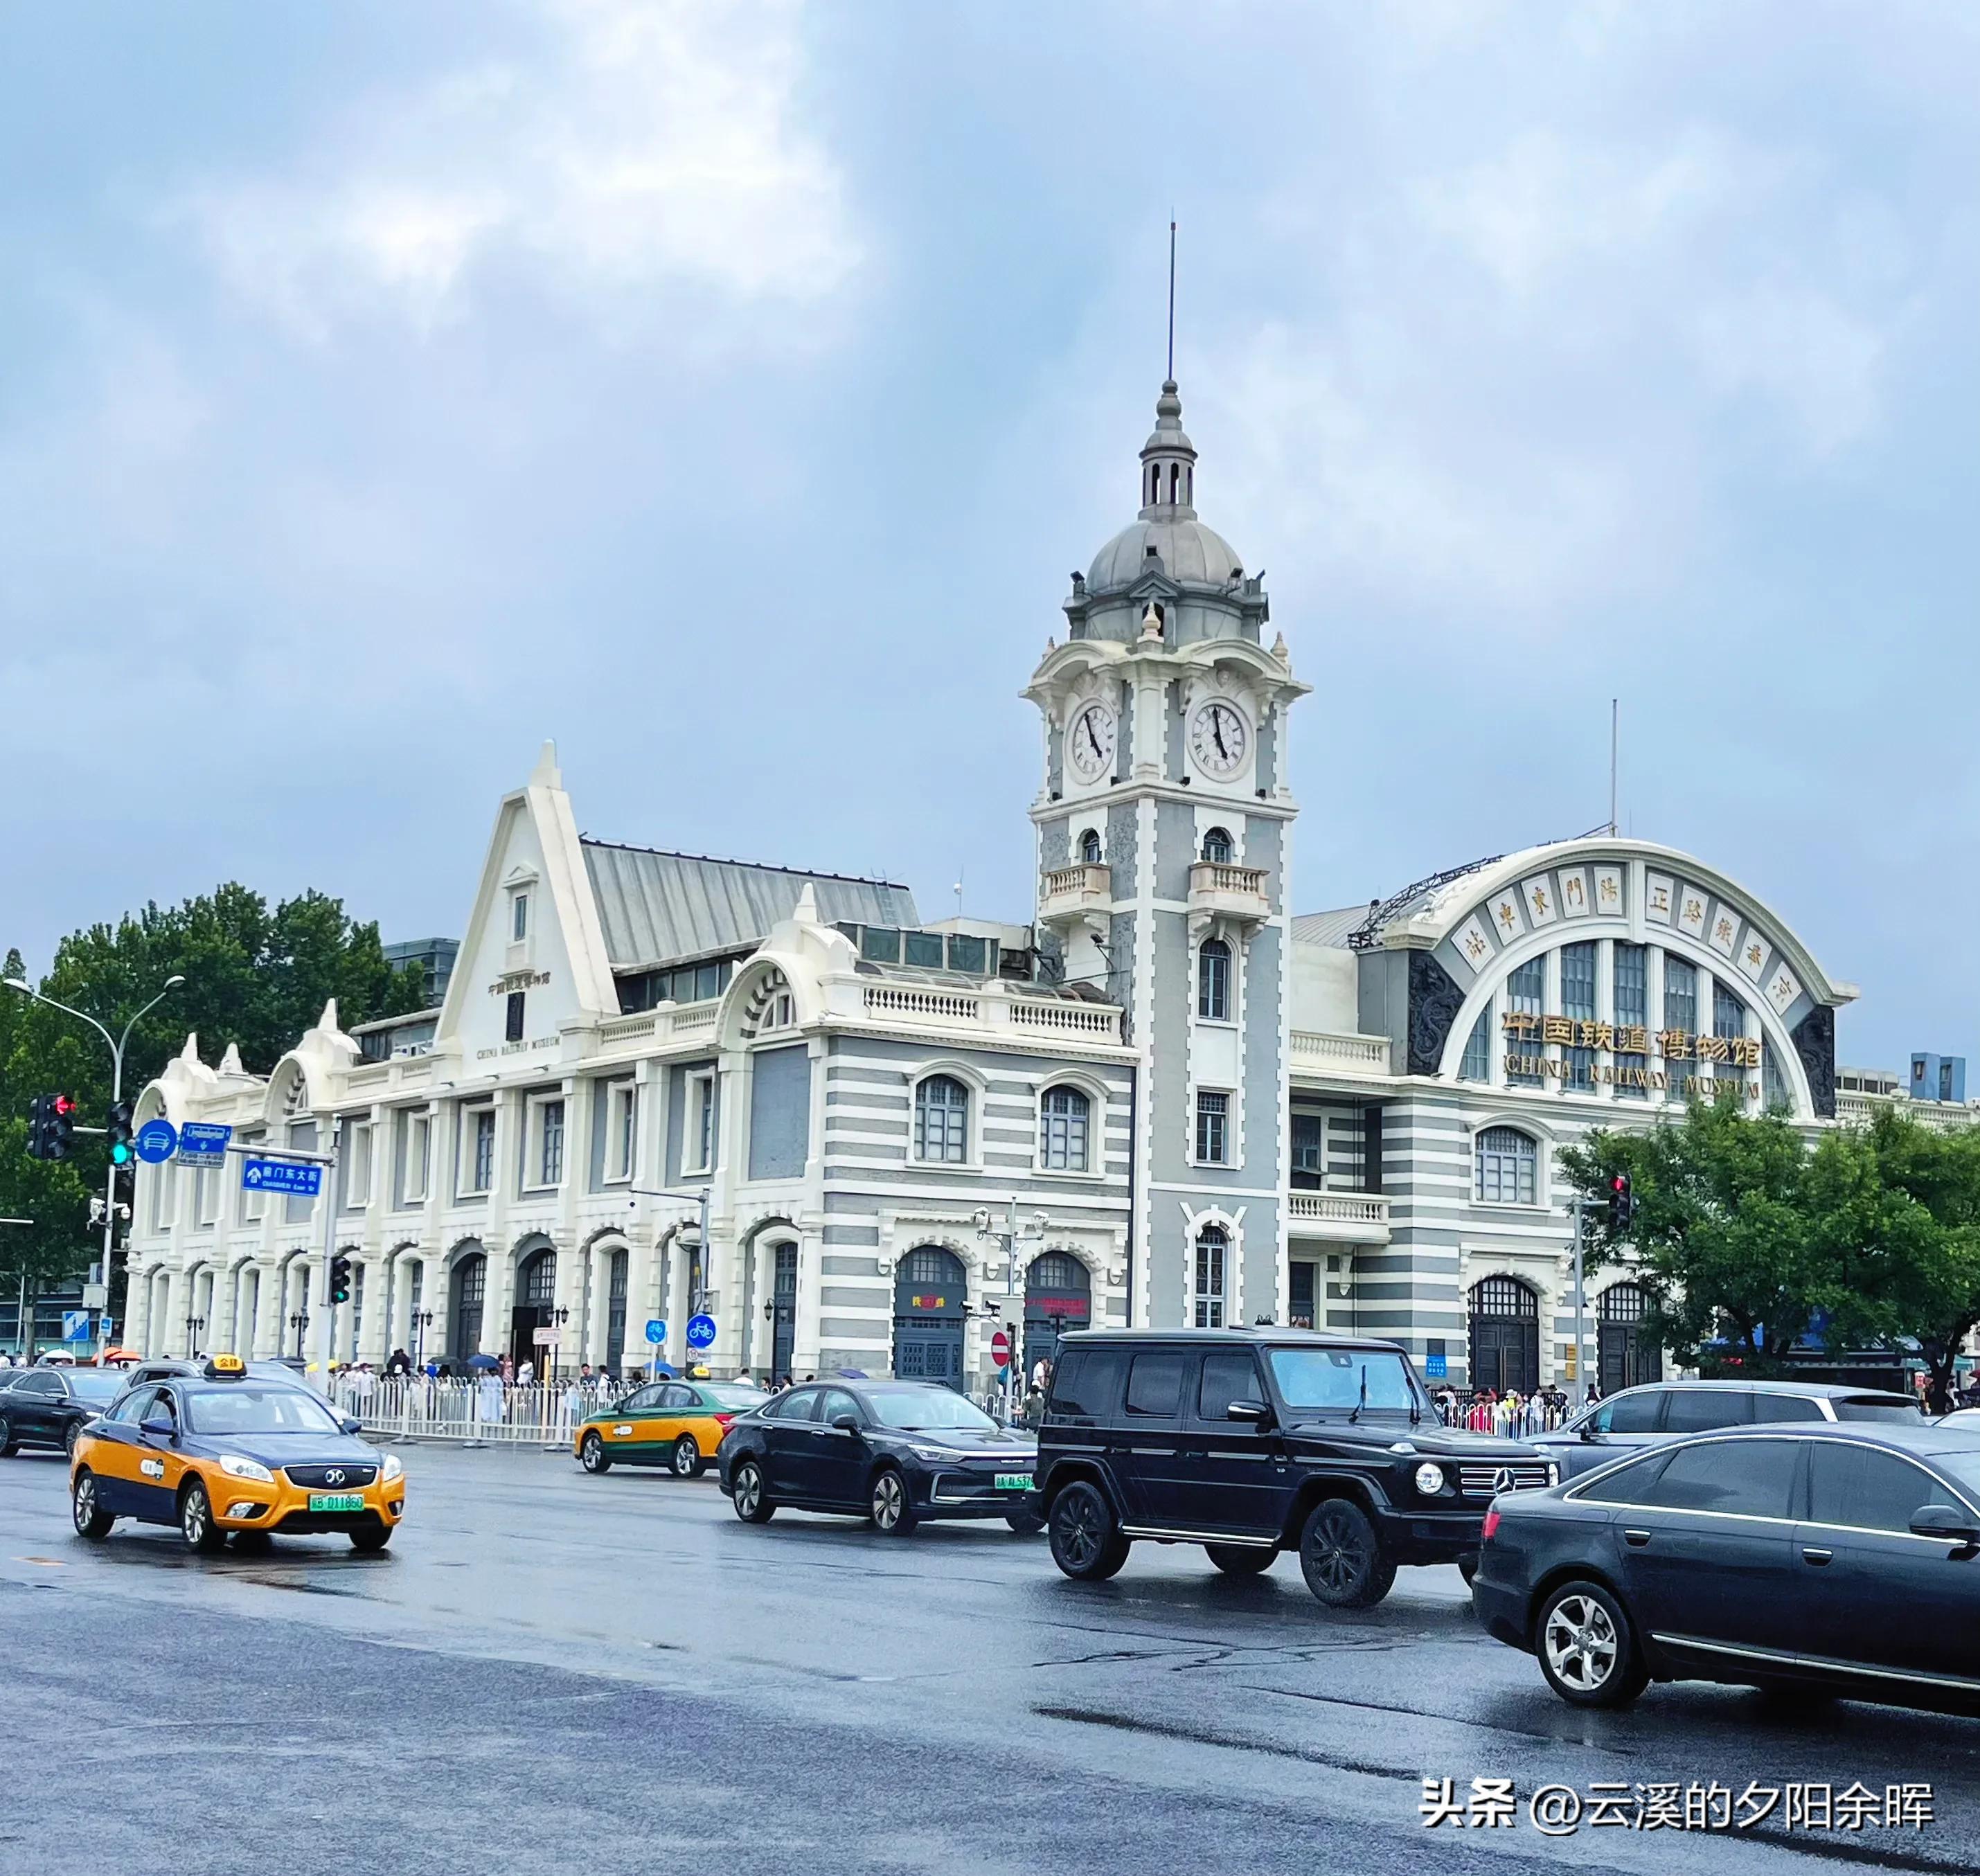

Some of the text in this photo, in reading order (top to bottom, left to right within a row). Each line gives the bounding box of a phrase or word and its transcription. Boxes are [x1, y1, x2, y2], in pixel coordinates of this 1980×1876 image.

[1502, 1011, 1762, 1069] 中国铁道博物馆
[1504, 1053, 1760, 1100] CHINA RAILWAY MUSEUM
[262, 1166, 318, 1182] 前门东大街
